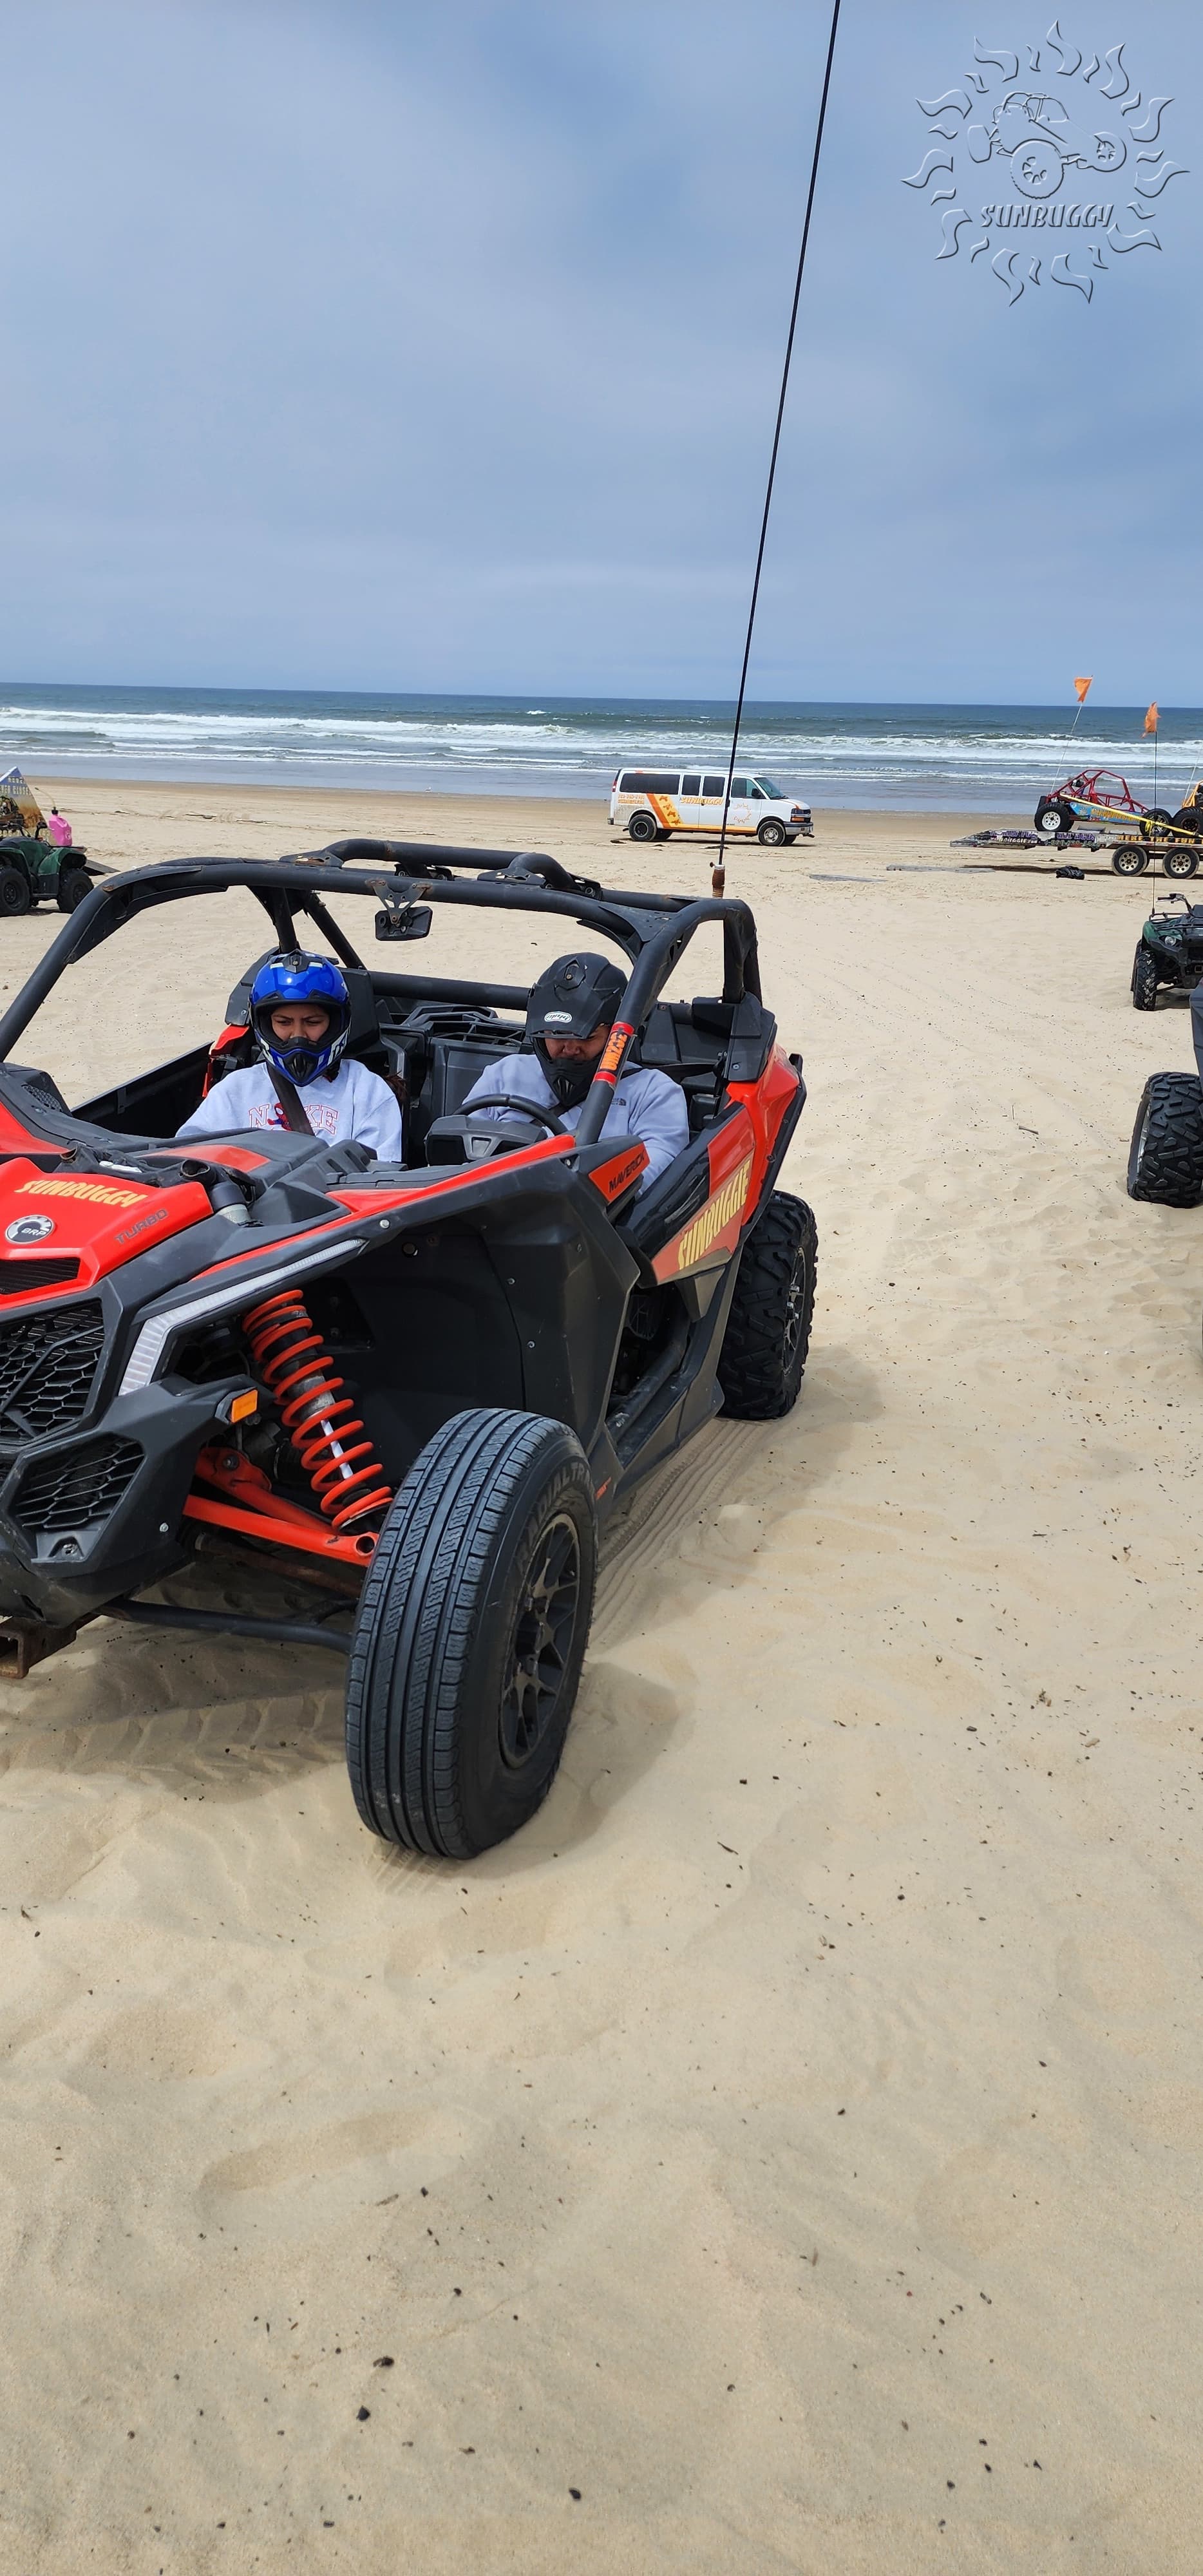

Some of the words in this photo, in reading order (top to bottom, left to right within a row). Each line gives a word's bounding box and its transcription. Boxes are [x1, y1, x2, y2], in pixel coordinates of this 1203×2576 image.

[15, 1180, 148, 1208] SUNBUGGY
[21, 1227, 47, 1236] BRP
[114, 1208, 169, 1245] TURBO
